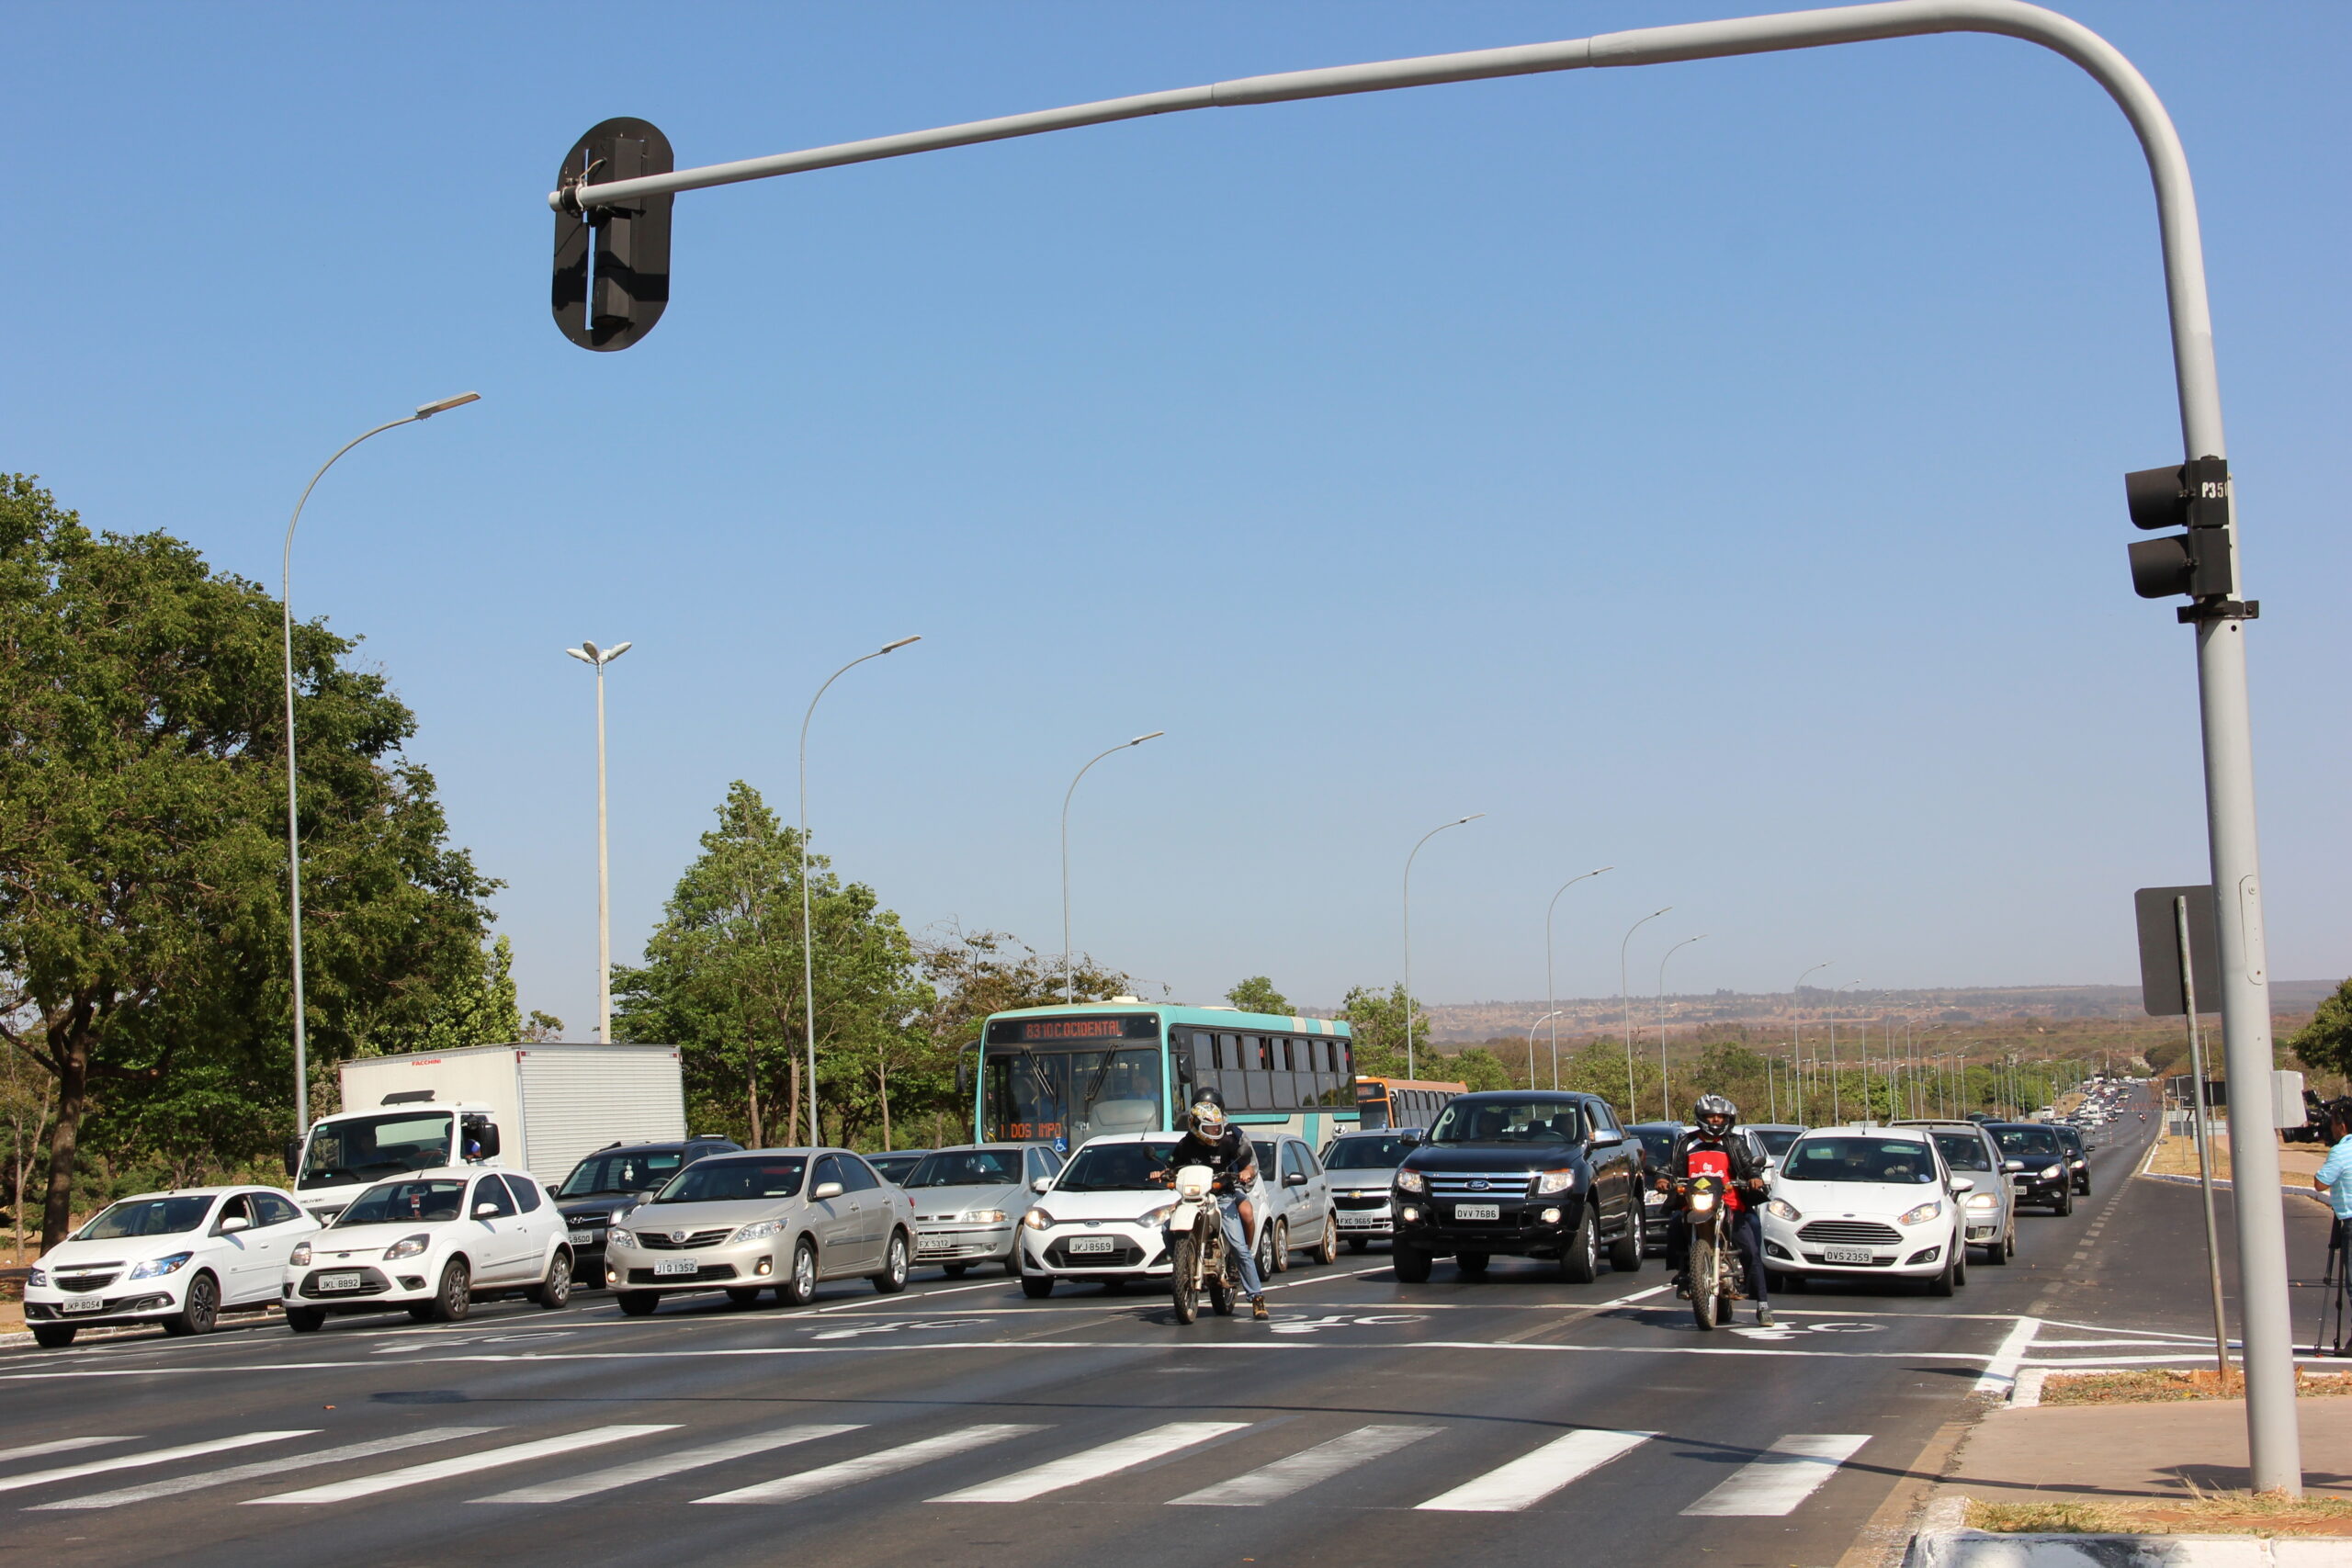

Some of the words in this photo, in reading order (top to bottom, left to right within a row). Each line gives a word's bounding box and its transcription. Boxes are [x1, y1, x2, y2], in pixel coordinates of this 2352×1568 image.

[1011, 1122, 1032, 1139] DOS
[1476, 1209, 1497, 1219] 7686
[573, 1235, 591, 1244] 9500
[1846, 1252, 1870, 1262] 2359
[321, 1280, 335, 1290] JKL
[338, 1279, 358, 1288] 8892
[65, 1301, 80, 1311] JKP
[81, 1300, 100, 1309] 8054
